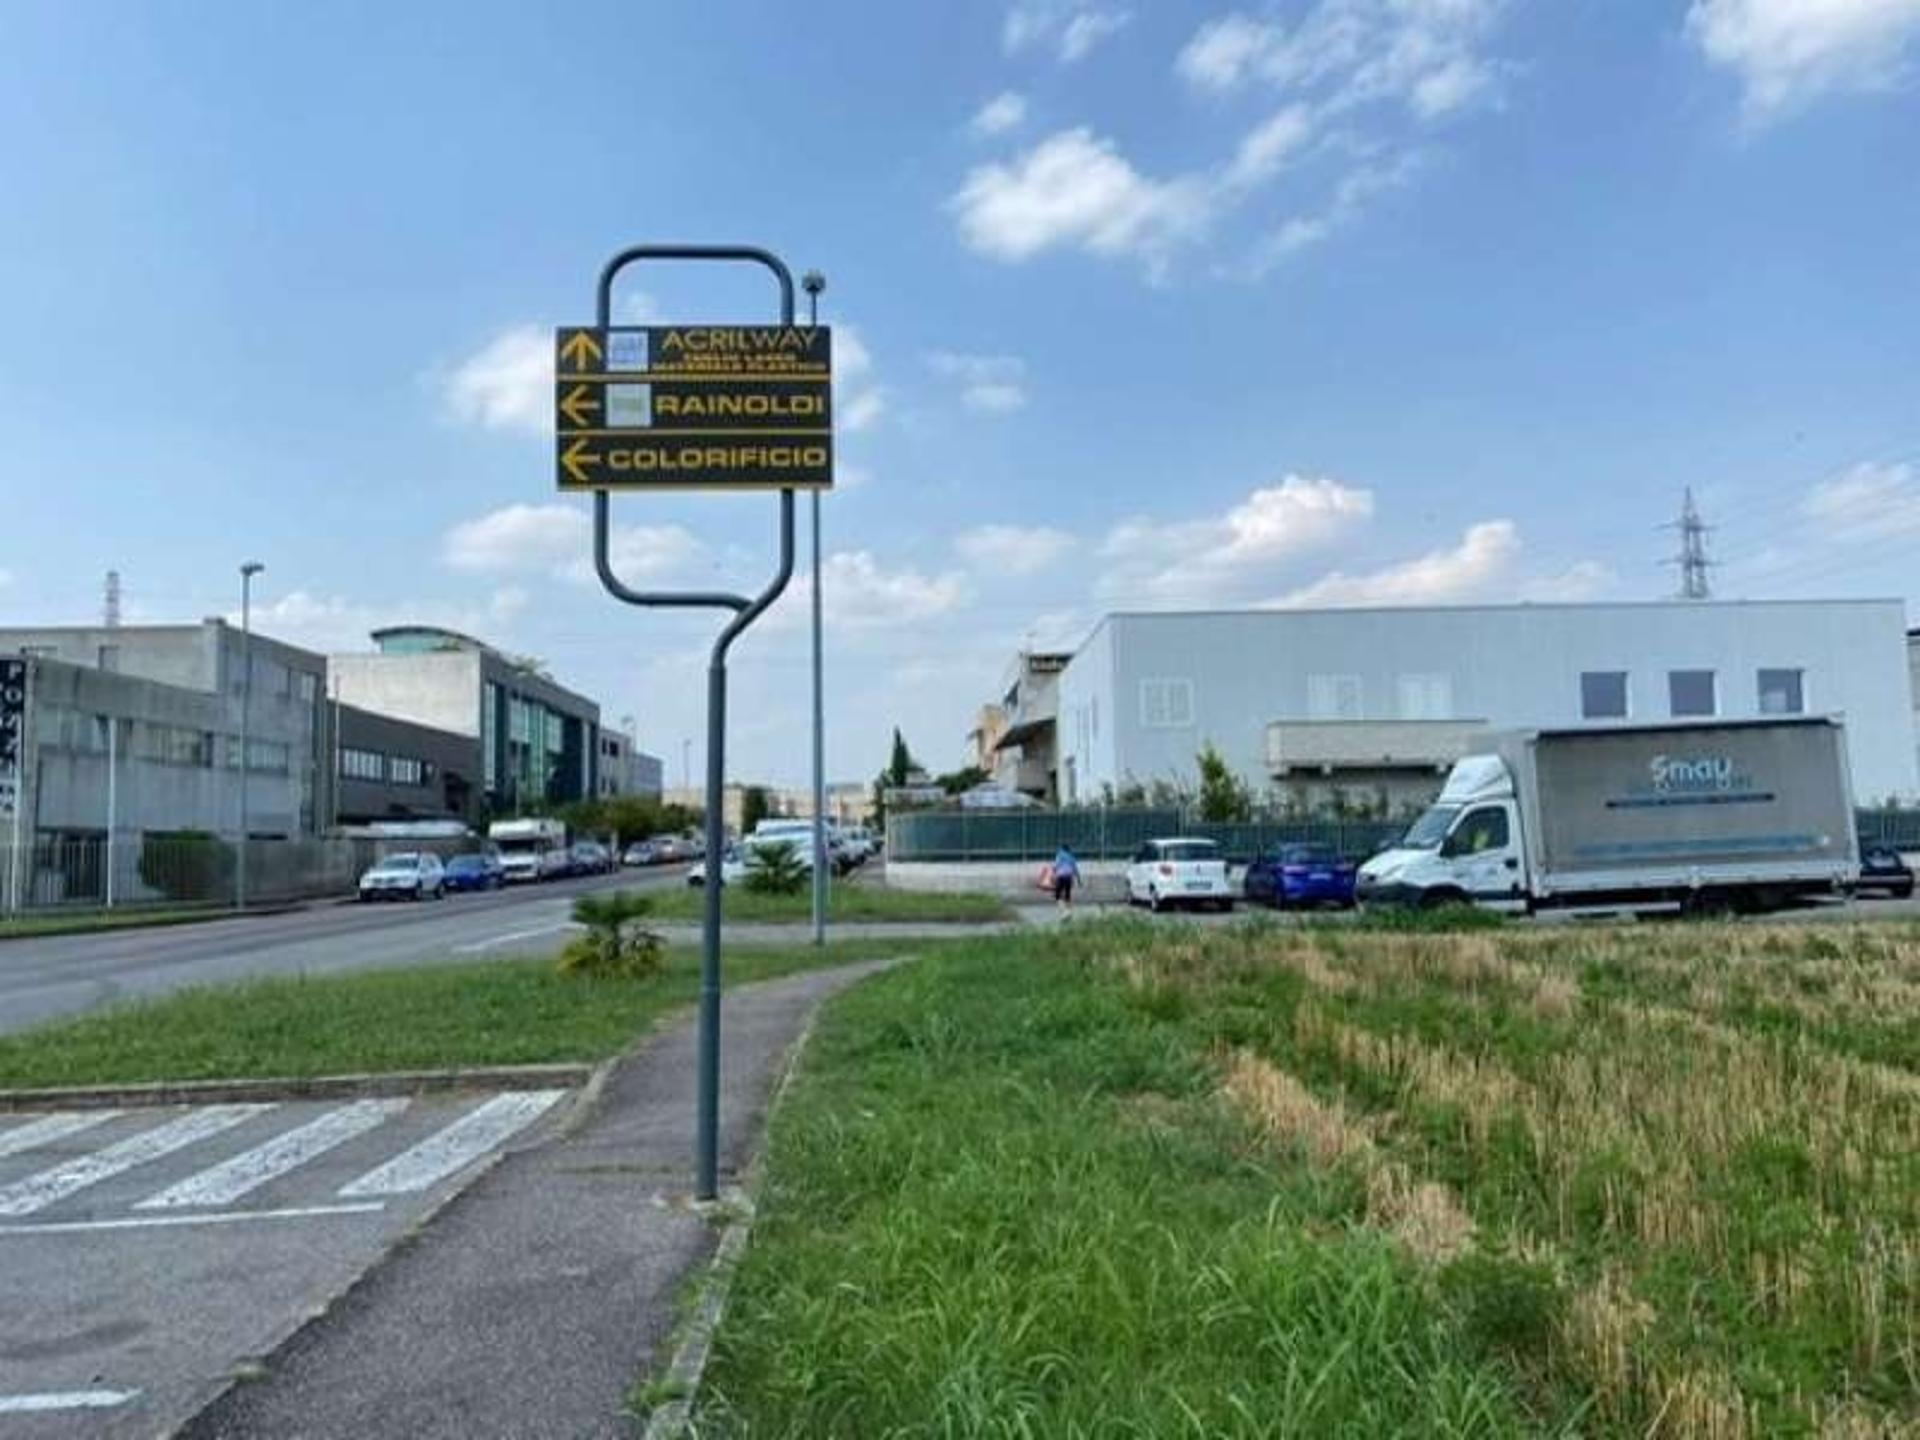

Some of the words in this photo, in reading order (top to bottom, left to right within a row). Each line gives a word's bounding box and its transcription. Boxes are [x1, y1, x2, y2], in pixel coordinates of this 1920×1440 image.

[661, 329, 817, 351] ACRILWAY
[656, 394, 824, 415] RAINOLDI
[608, 447, 827, 470] COLORIFICIO
